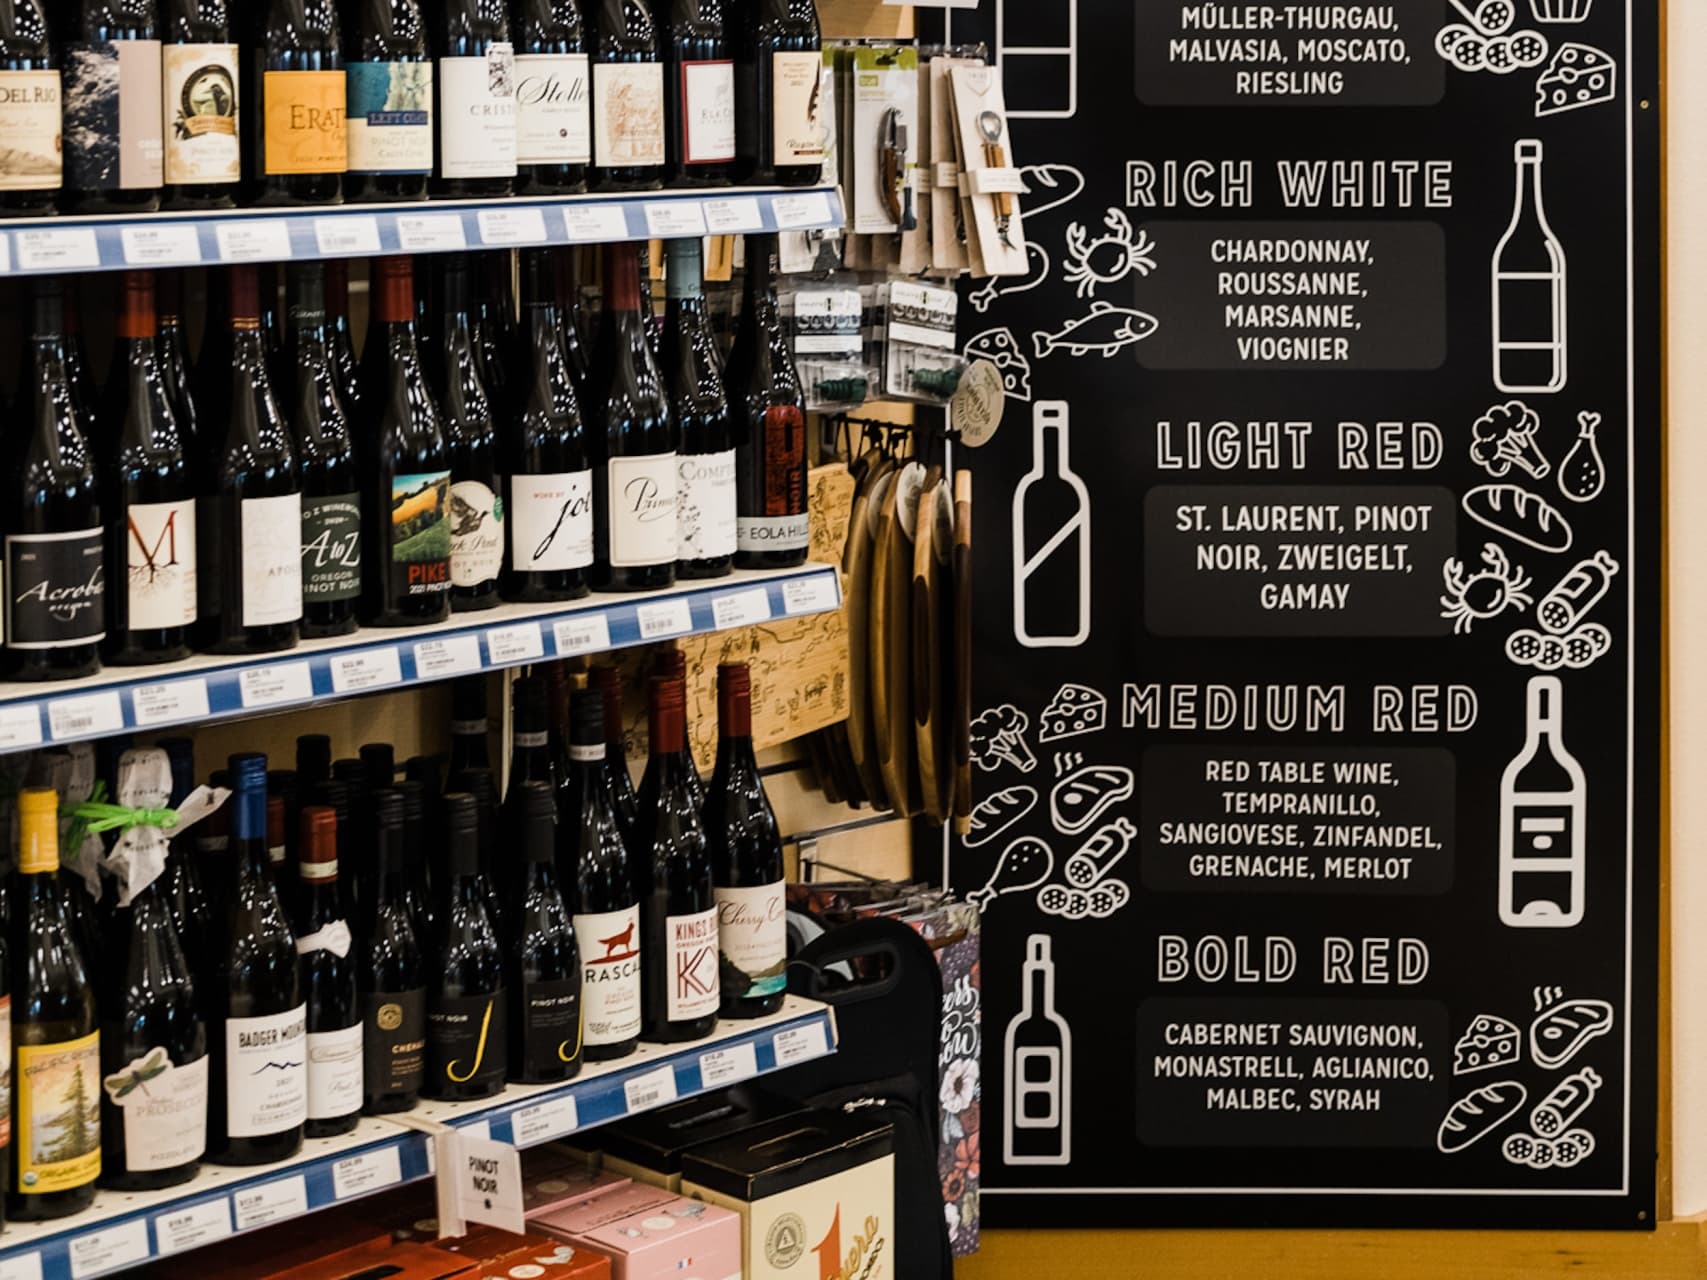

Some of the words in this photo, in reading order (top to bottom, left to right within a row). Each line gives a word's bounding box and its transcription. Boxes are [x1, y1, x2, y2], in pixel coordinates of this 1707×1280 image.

[1169, 38, 1288, 64] MALVASIA,
[1298, 38, 1411, 65] MOSCATO,
[1236, 71, 1344, 95] RIESLING
[288, 104, 347, 133] ERAT
[1126, 159, 1252, 208] RICH
[1277, 160, 1452, 208] WHITE
[1211, 239, 1374, 265] CHARDONNAY,
[1218, 272, 1368, 298] ROUSSANNE,
[1225, 304, 1361, 330] MARSANNE,
[1237, 337, 1349, 361] VIOGNIER
[1157, 421, 1313, 470] LIGHT
[1338, 422, 1443, 470] RED
[1176, 505, 1211, 531] ST.
[1222, 505, 1344, 534] LAURENT,
[1355, 505, 1433, 532] PINOT
[750, 526, 787, 541] EOLA
[1197, 544, 1268, 573] NOIR,
[1278, 544, 1413, 573] ZWEIGELT,
[311, 570, 354, 583] OREGON
[408, 561, 446, 585] PIKE
[303, 581, 335, 594] INOT
[1260, 583, 1350, 610] GAMAY
[1122, 683, 1345, 732] MEDIUM
[1373, 684, 1478, 732] RED
[1206, 760, 1250, 782] RED
[1258, 761, 1325, 784] TABLE
[1333, 762, 1399, 786] WINE,
[1222, 791, 1381, 818] TEMPRANILLO,
[1159, 822, 1305, 848] SANGIOVESE,
[1313, 825, 1442, 850] ZINFANDEL,
[1189, 854, 1316, 880] GRENACHE,
[1324, 857, 1412, 879] MERLOT
[674, 919, 707, 942] KINGS
[1158, 935, 1297, 983] BOLD
[1323, 937, 1429, 985] RED
[530, 998, 557, 1008] PINOT
[238, 1027, 279, 1050] BADGER
[1165, 1023, 1281, 1045] CABERNET
[1289, 1024, 1423, 1049] SAUVIGNON,
[1154, 1055, 1304, 1080] MONASTRELL,
[1312, 1056, 1434, 1082] AGLIANICO,
[1207, 1088, 1301, 1112] MALBEC,
[1309, 1088, 1380, 1111] SYRAH
[468, 1155, 500, 1175] PINOT
[472, 1175, 499, 1195] NOIR
